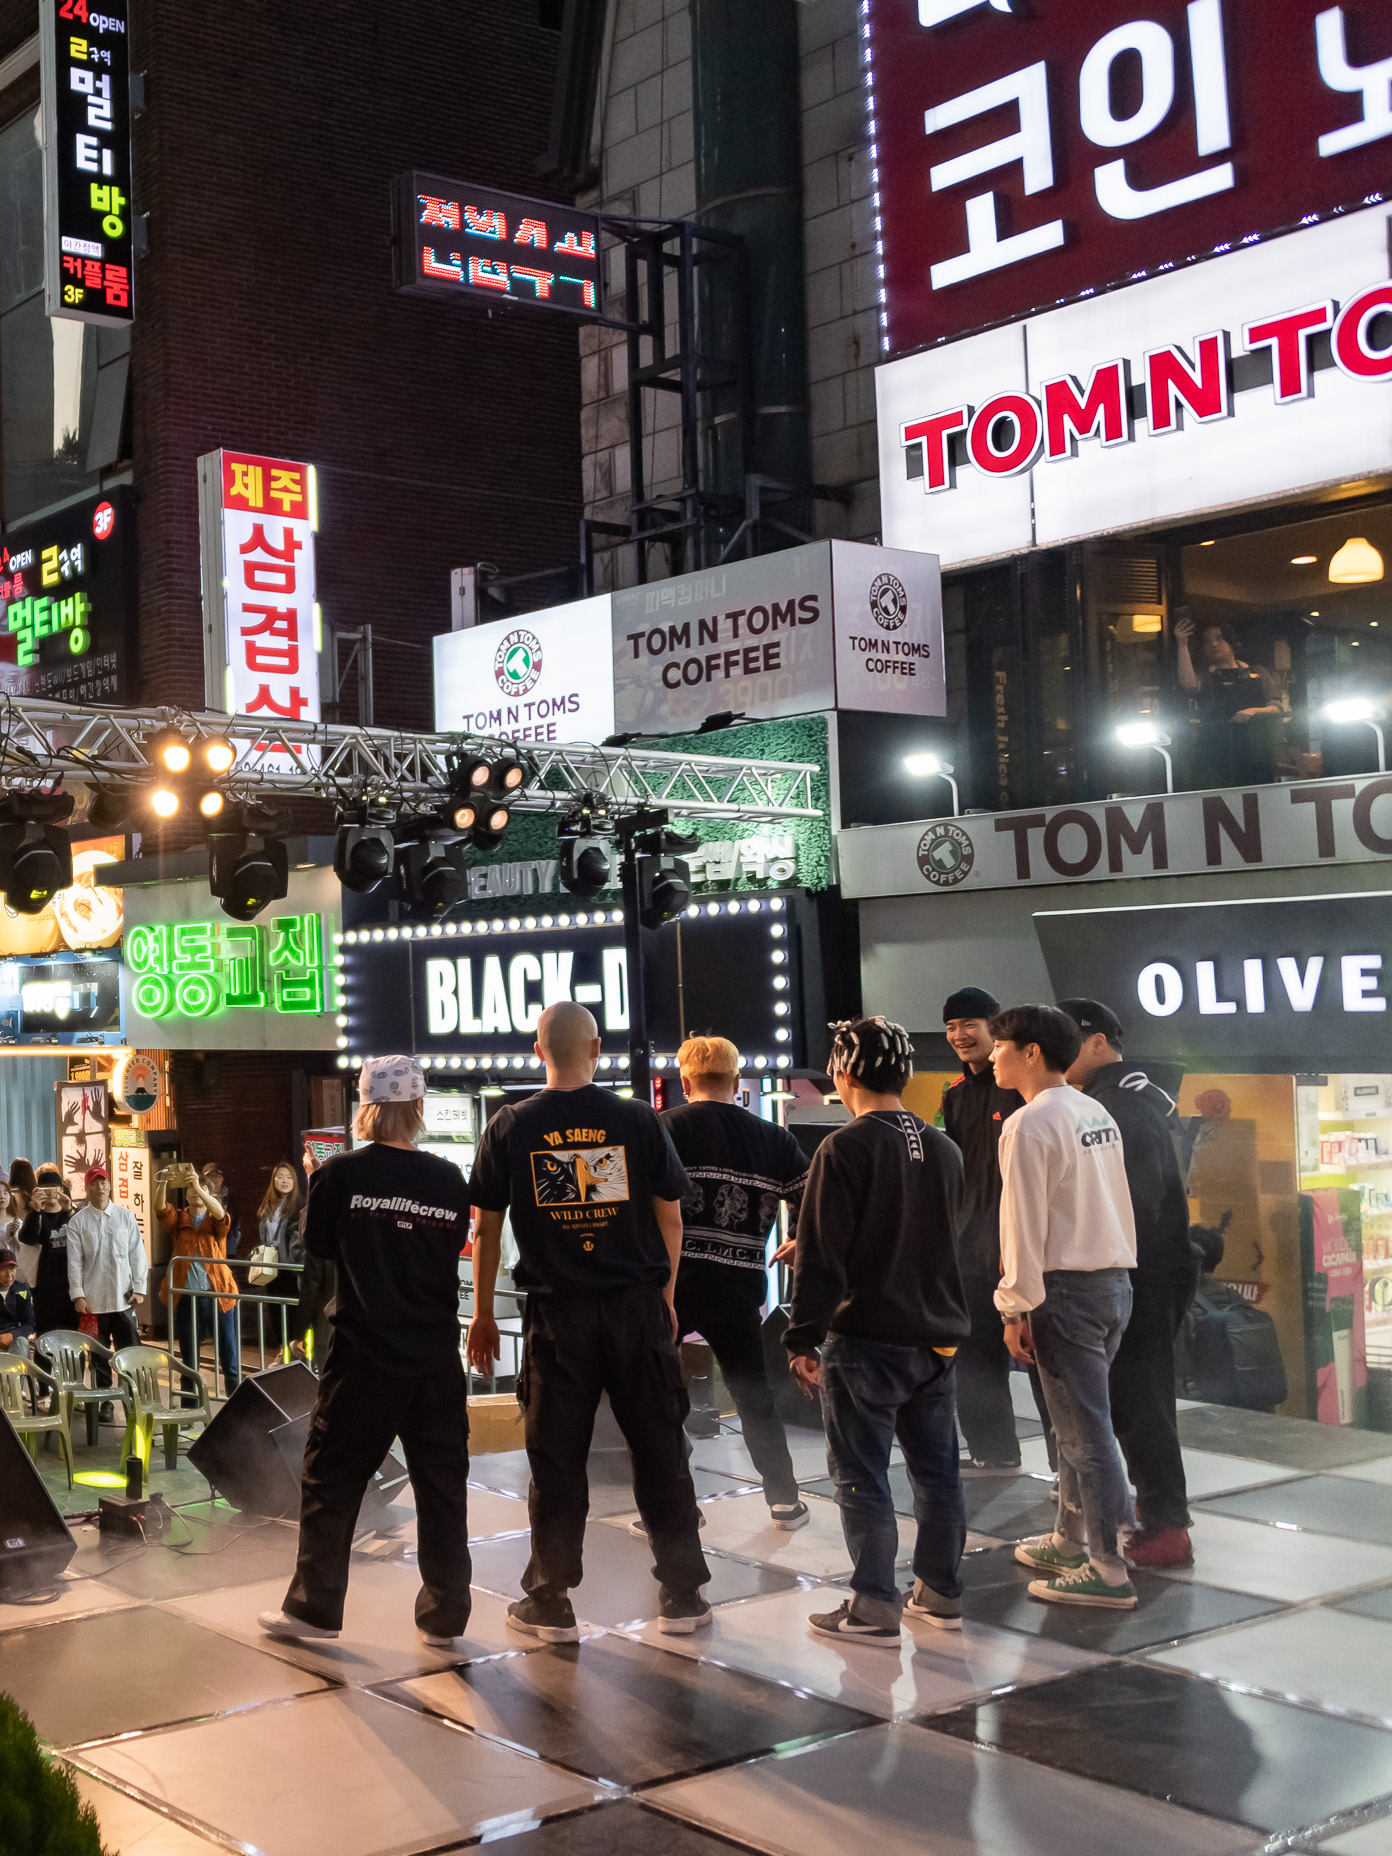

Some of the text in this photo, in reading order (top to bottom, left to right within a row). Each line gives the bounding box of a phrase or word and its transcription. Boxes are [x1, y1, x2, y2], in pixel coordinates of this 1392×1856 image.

[924, 0, 1235, 291] 코인
[62, 256, 130, 308] 커플룸
[64, 284, 84, 304] 3F
[899, 357, 1131, 495] TOM
[1143, 329, 1235, 438] N
[230, 461, 303, 513] 제주
[94, 507, 113, 535] 3F
[8, 591, 86, 668] 멀티방
[627, 594, 821, 660] TOM N TOMS
[872, 607, 906, 630] COFFEE
[661, 640, 782, 690] COFFEE
[849, 635, 930, 659] TOM N TOMS
[865, 657, 916, 676] COFFEE
[497, 668, 540, 696] COFFEE
[462, 692, 580, 732] TOM N TOMS
[994, 778, 1392, 880] TOM N TO
[466, 858, 559, 900] EAUTY
[921, 860, 971, 885] COFFEE
[127, 913, 323, 1019] 영동교집
[1136, 953, 1388, 1018] OLIVE
[141, 1057, 158, 1093] COMPANY
[543, 1128, 607, 1147] YA SAENG
[117, 1150, 130, 1203] 삼겹
[550, 1206, 619, 1221] WILD CREW
